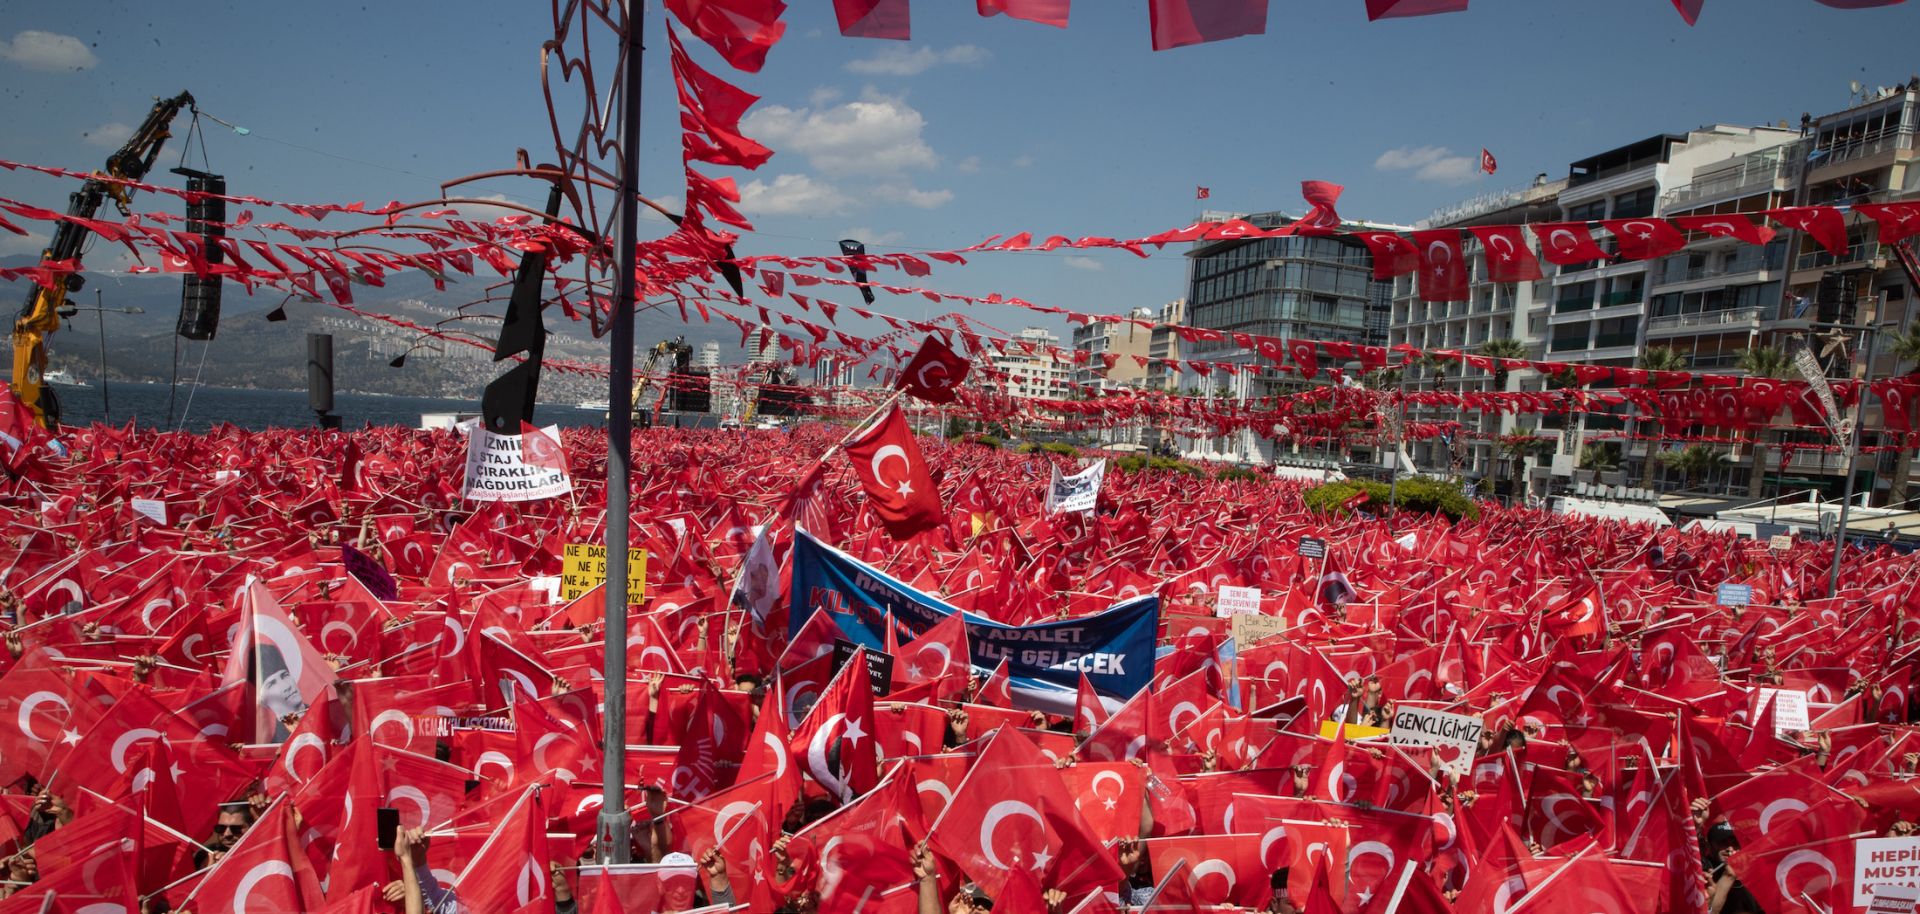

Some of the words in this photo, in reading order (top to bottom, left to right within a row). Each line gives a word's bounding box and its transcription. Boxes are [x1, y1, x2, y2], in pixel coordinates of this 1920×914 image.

[480, 451, 512, 466] STAJ
[475, 464, 548, 478] ÇIRAKLIK
[466, 473, 566, 491] MAĞDURLARI
[566, 546, 580, 557] NE
[578, 561, 591, 573] NE
[564, 575, 577, 586] NE
[580, 576, 589, 587] de
[988, 627, 1084, 643] ADALET
[978, 640, 1014, 662] İLE
[1020, 649, 1126, 676] GELECEK
[1395, 712, 1482, 743] GENÇLİĞİMİZ
[1871, 845, 1920, 862] HEPİ
[1864, 865, 1920, 879] MUST
